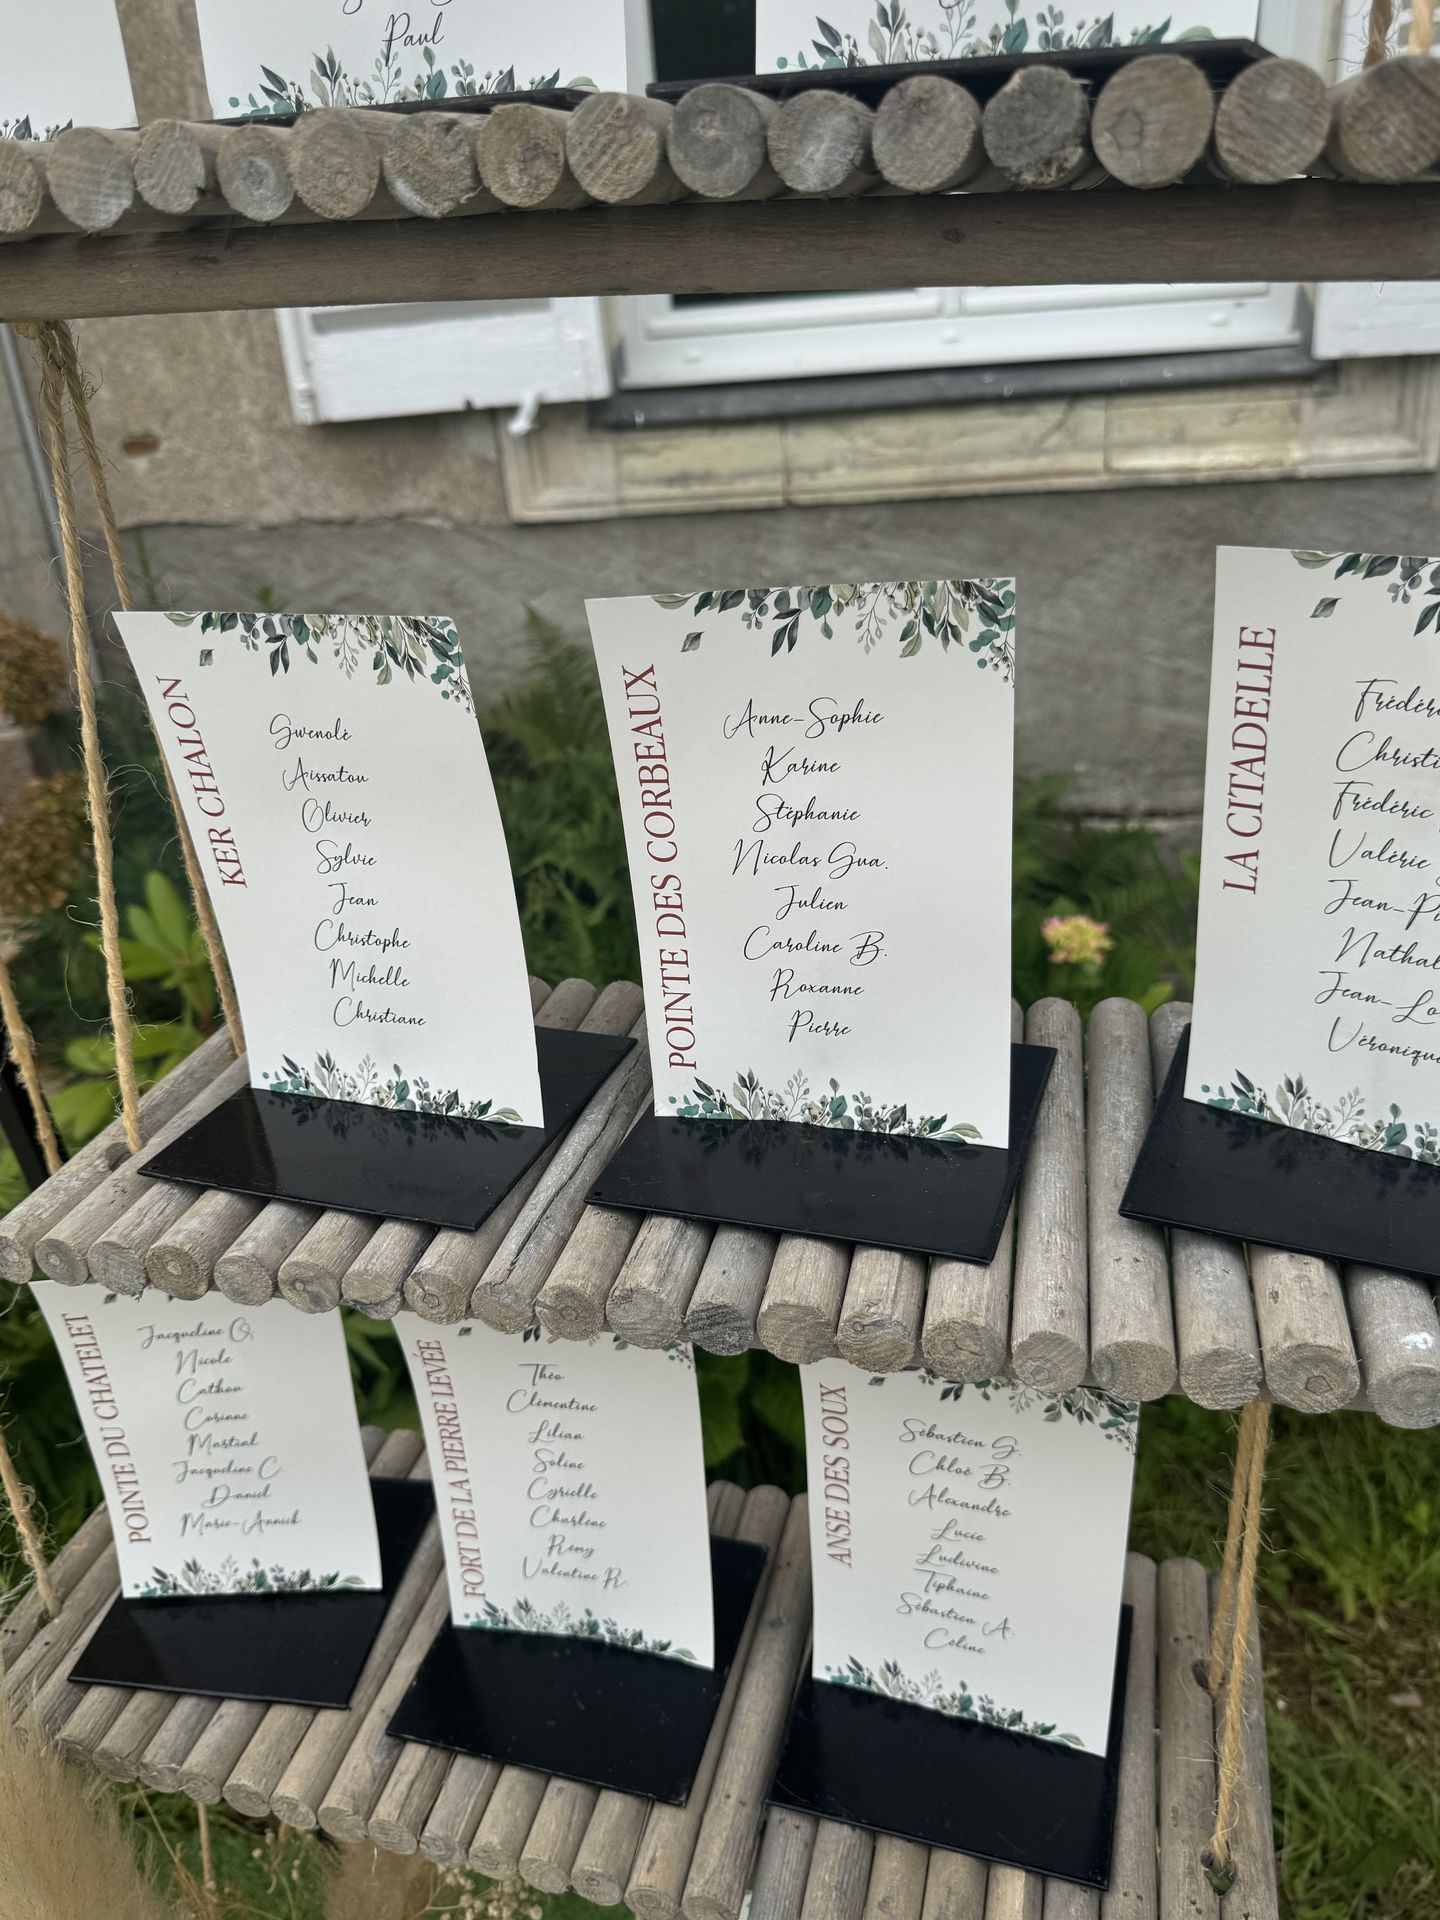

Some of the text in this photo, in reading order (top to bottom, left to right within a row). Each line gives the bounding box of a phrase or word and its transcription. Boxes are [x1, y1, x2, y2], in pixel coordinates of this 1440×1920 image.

[381, 11, 445, 67] Paul
[270, 713, 353, 750] Gwenolé
[723, 697, 885, 740] Anne-Sophie
[283, 757, 369, 792] Aissatou
[761, 746, 841, 786] Karine
[1222, 625, 1278, 895] LA CITADELLE
[156, 675, 248, 889] KER CHALON
[1333, 781, 1434, 821] Frédéric
[302, 799, 372, 833] Olivier
[752, 794, 861, 834] Stéphanie
[316, 840, 378, 874] Sylvie
[621, 664, 697, 1070] POINTE DES CORBEAUX
[732, 839, 888, 879] Nicolas Gua.
[1329, 829, 1431, 868] Valérie
[328, 882, 379, 918] Jean
[774, 885, 848, 920] Julien
[314, 919, 411, 952] Christophe
[743, 925, 888, 966] Caroline B.
[329, 958, 411, 991] Michelle
[770, 968, 864, 1002] Roxanne
[332, 997, 428, 1028] Christiane
[787, 1010, 852, 1043] Pierre
[62, 1312, 151, 1545] POINTE DU CHATELET
[434, 1401, 469, 1474] PIERRE
[448, 1478, 475, 1506] LA
[820, 1383, 852, 1568] ANSE DES SOUX
[452, 1508, 480, 1539] DE
[456, 1541, 487, 1600] FORT
